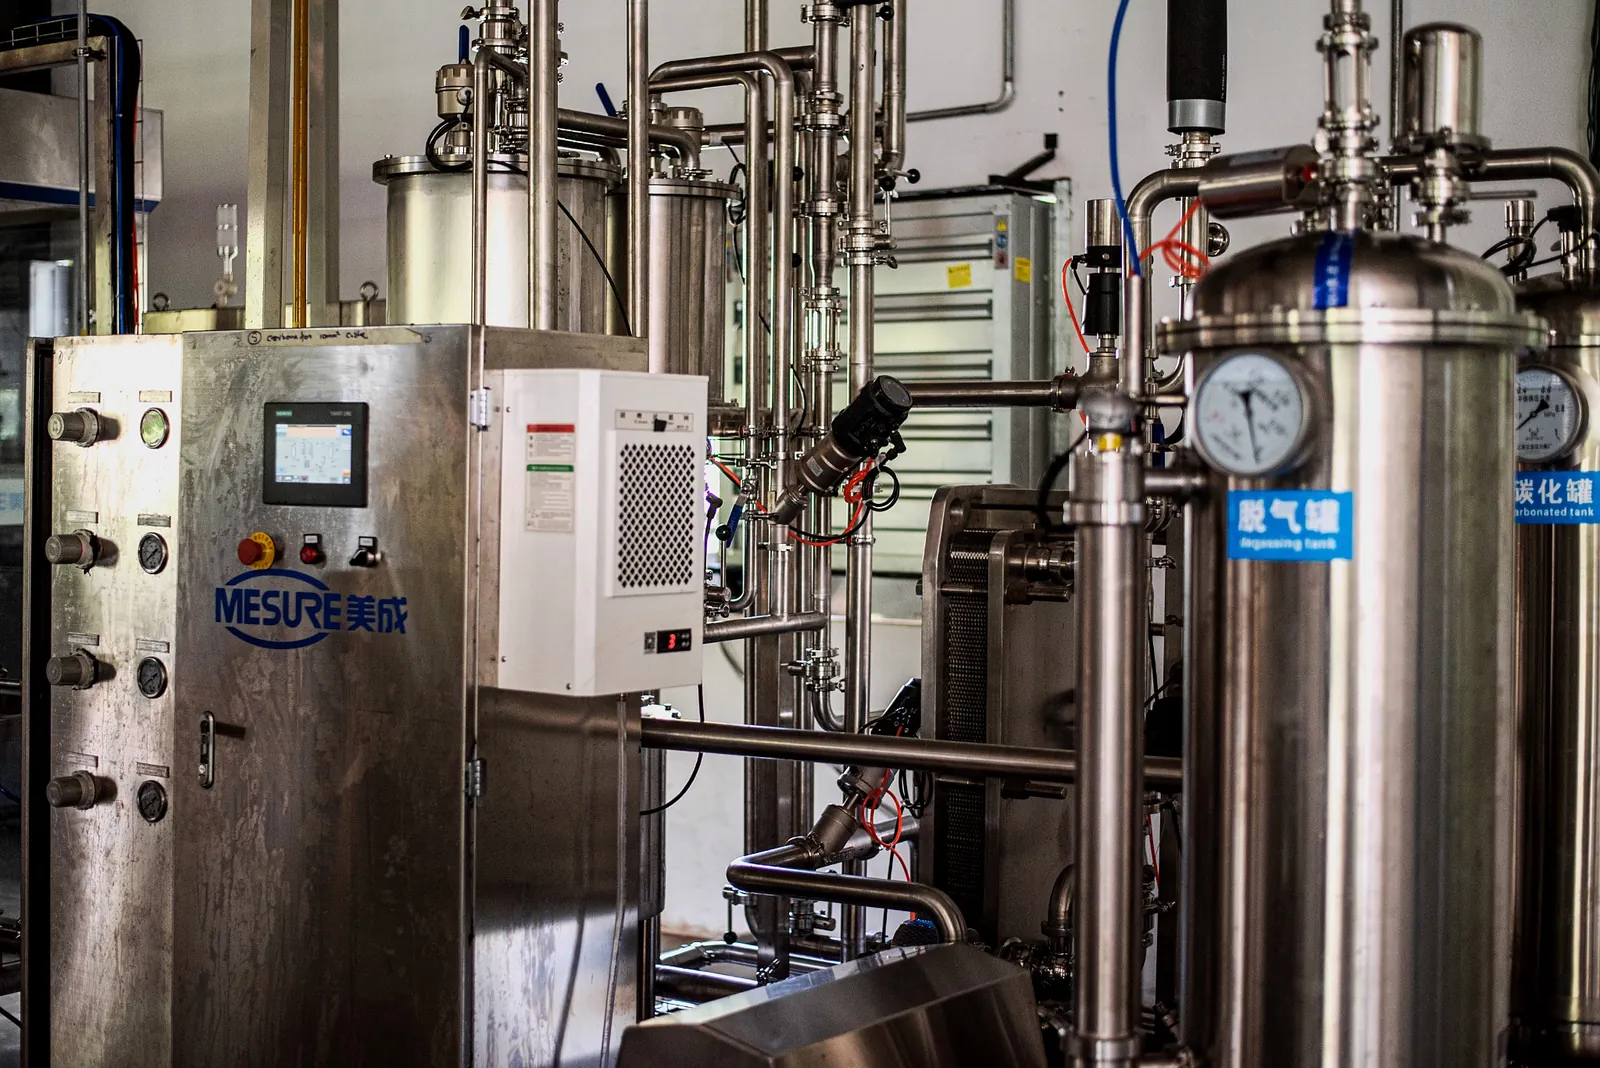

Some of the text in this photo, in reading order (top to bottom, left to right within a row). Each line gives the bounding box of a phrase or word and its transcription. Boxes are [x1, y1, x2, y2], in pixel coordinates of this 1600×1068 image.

[1514, 478, 1593, 505] 碳化罐
[1515, 507, 1594, 517] arbonated tank
[215, 588, 408, 634] MESURE 美成
[668, 633, 676, 649] 3
